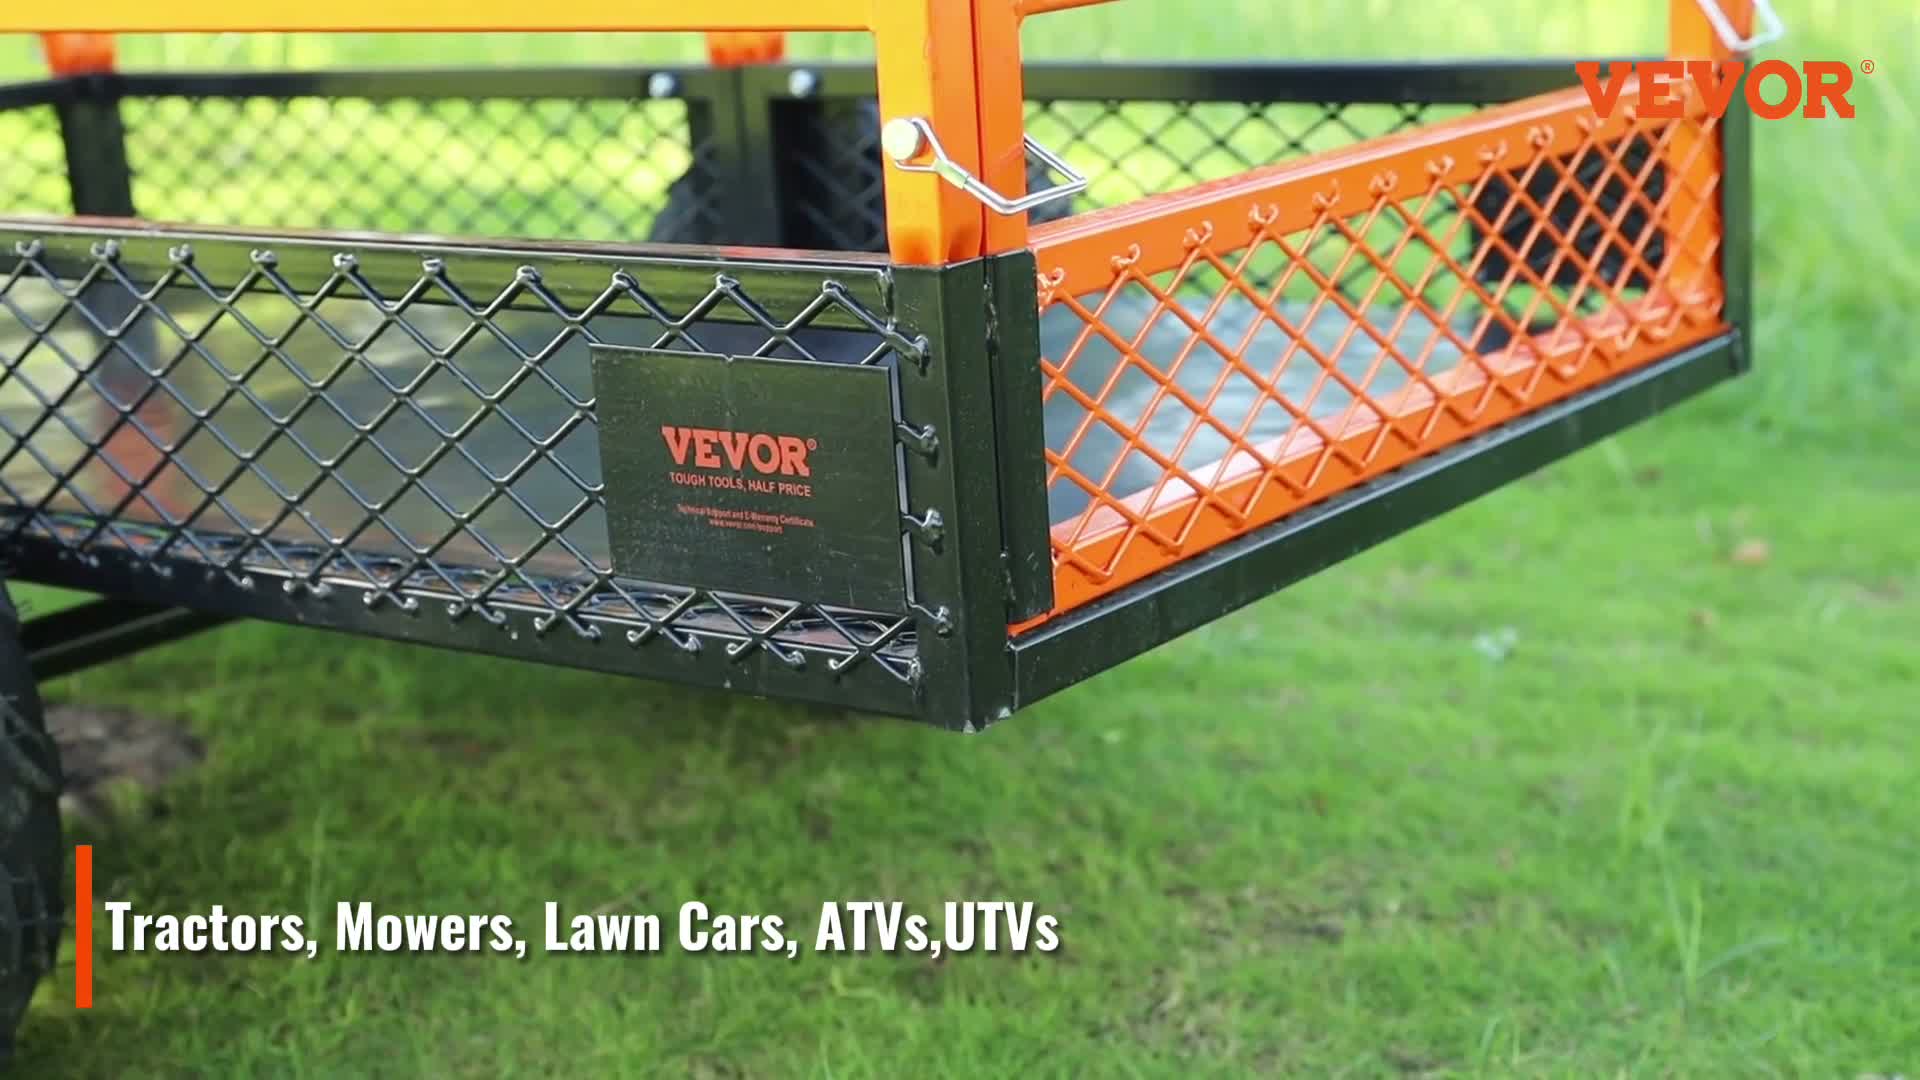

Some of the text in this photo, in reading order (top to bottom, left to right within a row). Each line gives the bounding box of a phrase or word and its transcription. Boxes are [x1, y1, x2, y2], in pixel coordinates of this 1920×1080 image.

[669, 471, 812, 497] TOUGH TOOLS, HALF PRICE
